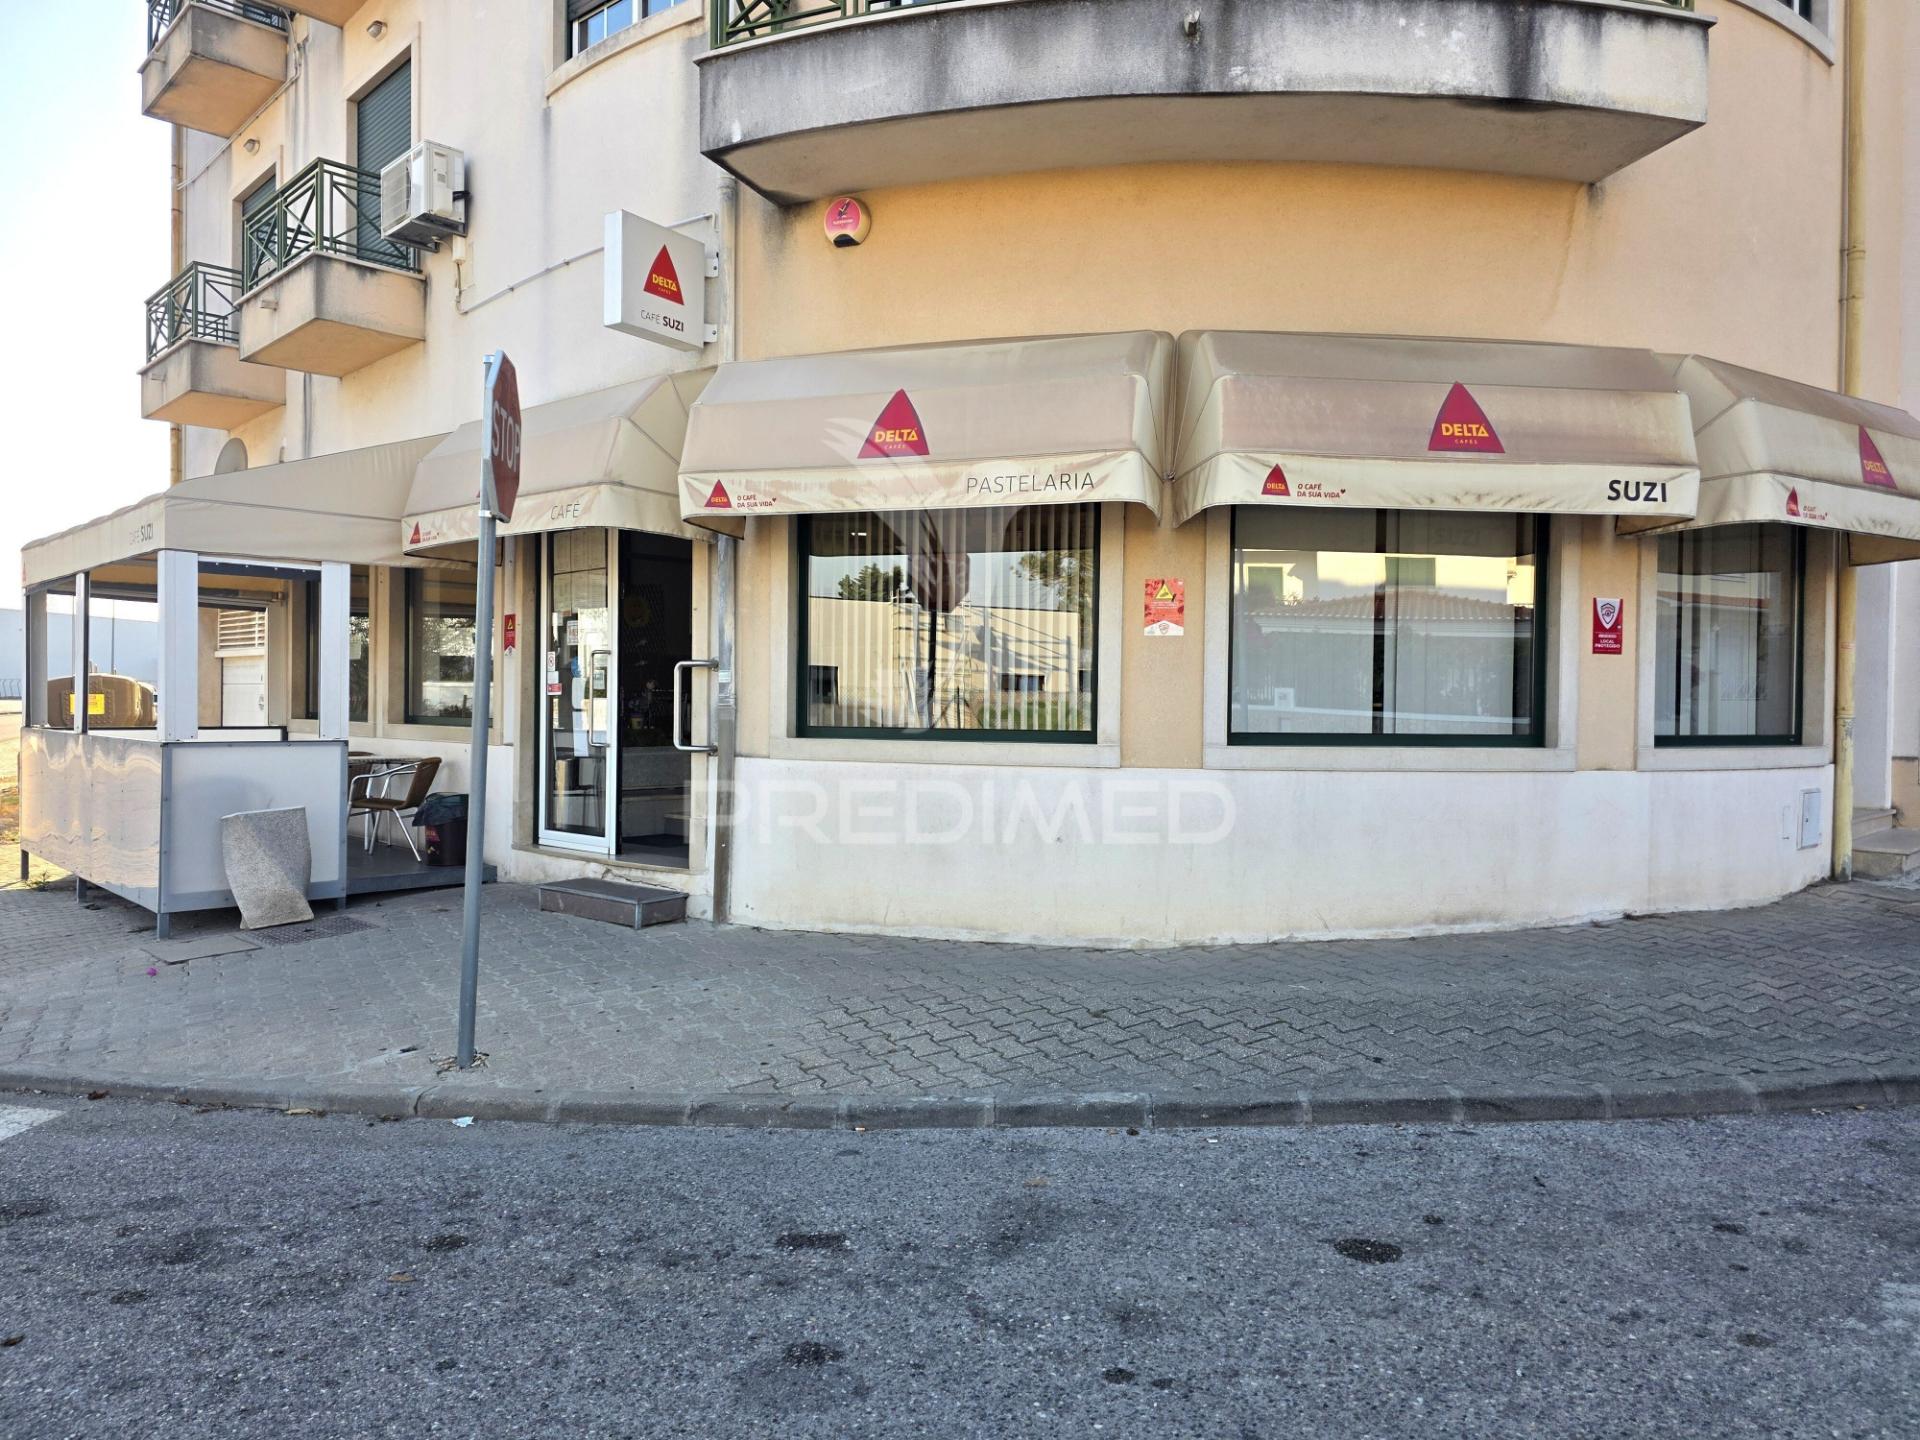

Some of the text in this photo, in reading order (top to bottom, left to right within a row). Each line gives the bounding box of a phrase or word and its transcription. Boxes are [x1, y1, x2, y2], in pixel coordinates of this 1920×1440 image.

[652, 273, 677, 292] DELTA
[662, 315, 684, 332] SUZI
[491, 400, 521, 473] STOP
[874, 428, 918, 443] DELTA
[1441, 423, 1489, 437] DELTA
[966, 472, 1095, 494] PASTELARIA
[1266, 482, 1286, 490] DELTA
[1607, 479, 1667, 503] SUZI
[550, 499, 580, 521] CAFÉ
[140, 522, 154, 543] SUZI
